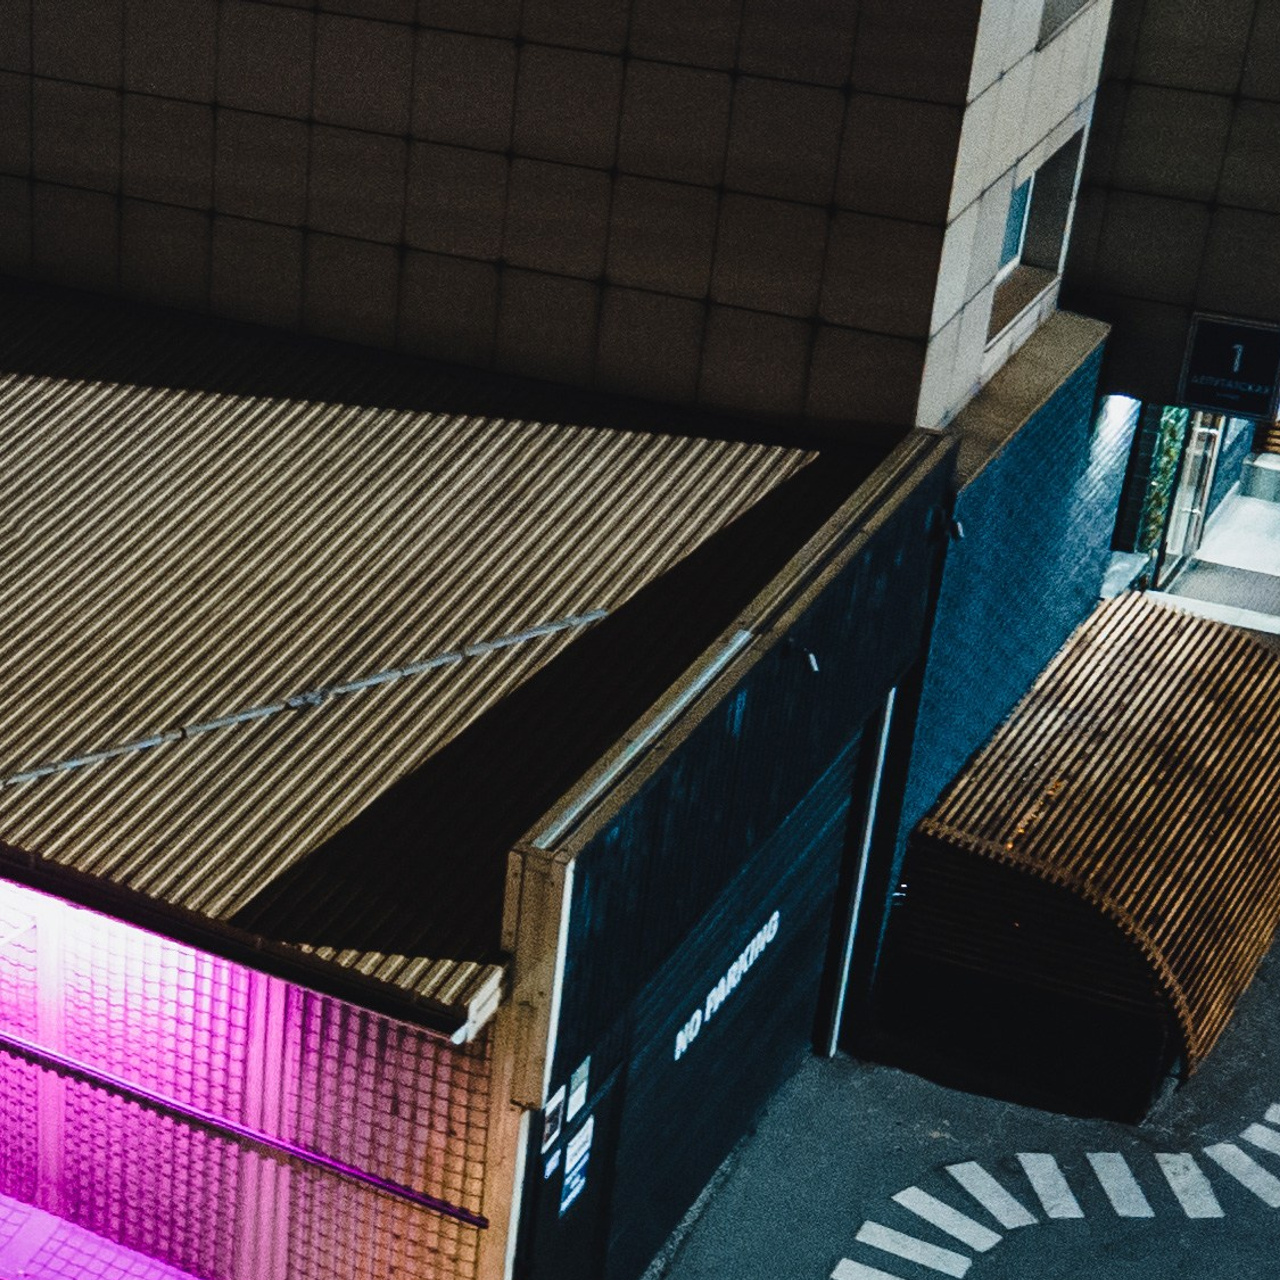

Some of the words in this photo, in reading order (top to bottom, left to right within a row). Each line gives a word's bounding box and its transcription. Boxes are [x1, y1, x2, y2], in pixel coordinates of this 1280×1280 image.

[1232, 344, 1243, 373] 1
[674, 1008, 702, 1061] NO
[704, 910, 780, 1022] PARKING
